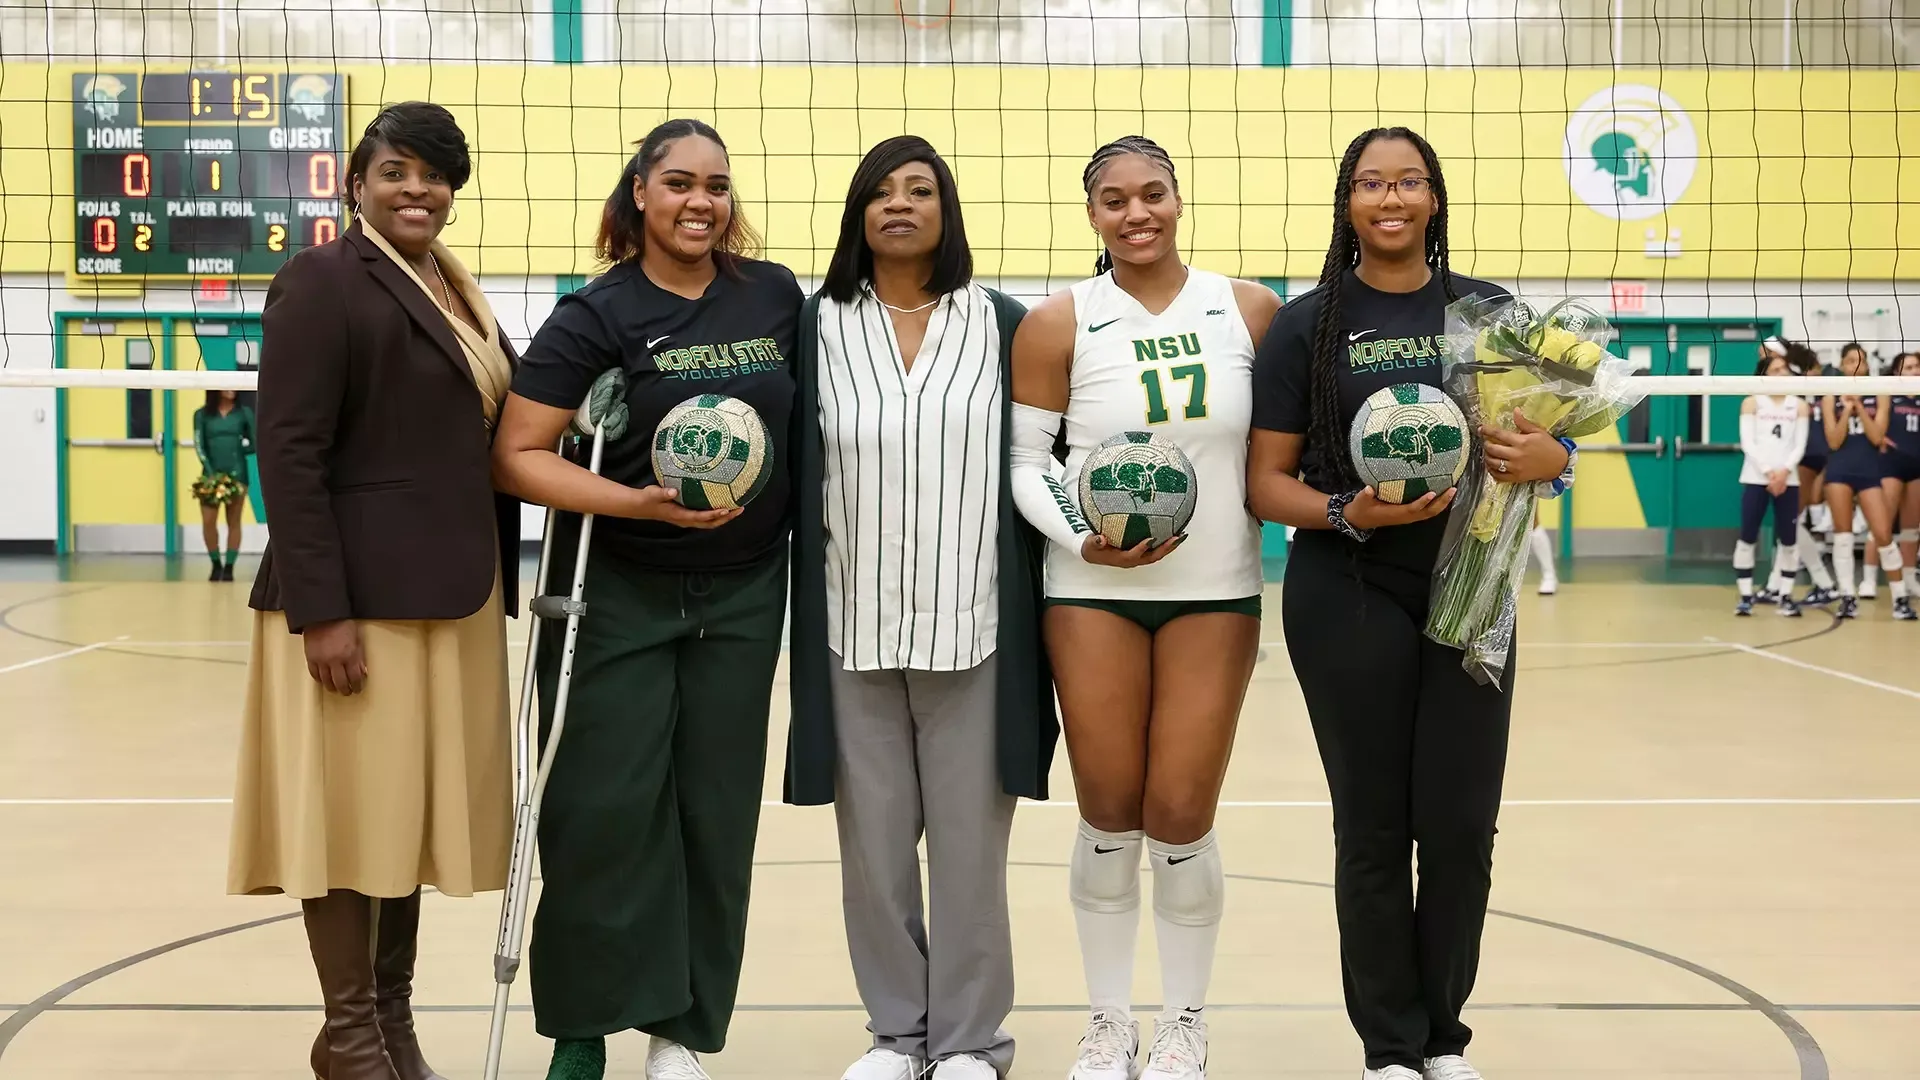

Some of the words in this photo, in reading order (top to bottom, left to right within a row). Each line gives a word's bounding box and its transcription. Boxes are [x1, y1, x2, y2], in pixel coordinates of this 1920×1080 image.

[192, 76, 270, 118] 1:15
[87, 128, 143, 149] HOME
[184, 139, 233, 154] PERIOD
[269, 127, 333, 148] GUEST
[124, 154, 150, 196] 0
[211, 160, 220, 190] 1
[310, 154, 335, 196] 0
[78, 201, 121, 216] FOULS
[167, 201, 217, 216] PLAYER
[221, 201, 256, 216] FOUL
[298, 201, 341, 216] FOULS
[94, 217, 116, 253] 0
[135, 225, 152, 251] 2
[268, 225, 286, 252] 2
[78, 258, 122, 273] SCORE
[187, 258, 233, 273] MATCH
[653, 345, 737, 372] NORFOLK
[731, 338, 784, 365] STATE
[1132, 332, 1202, 362] NSU
[1348, 335, 1437, 367] NORFOLK
[678, 361, 778, 380] VOLLEYBALL
[1368, 355, 1450, 373] VOLLEY
[1139, 363, 1209, 426] 17
[1772, 424, 1782, 439] 4
[1906, 414, 1918, 432] 11
[1093, 1013, 1105, 1021] NIKE
[1177, 1015, 1194, 1024] NIKE
